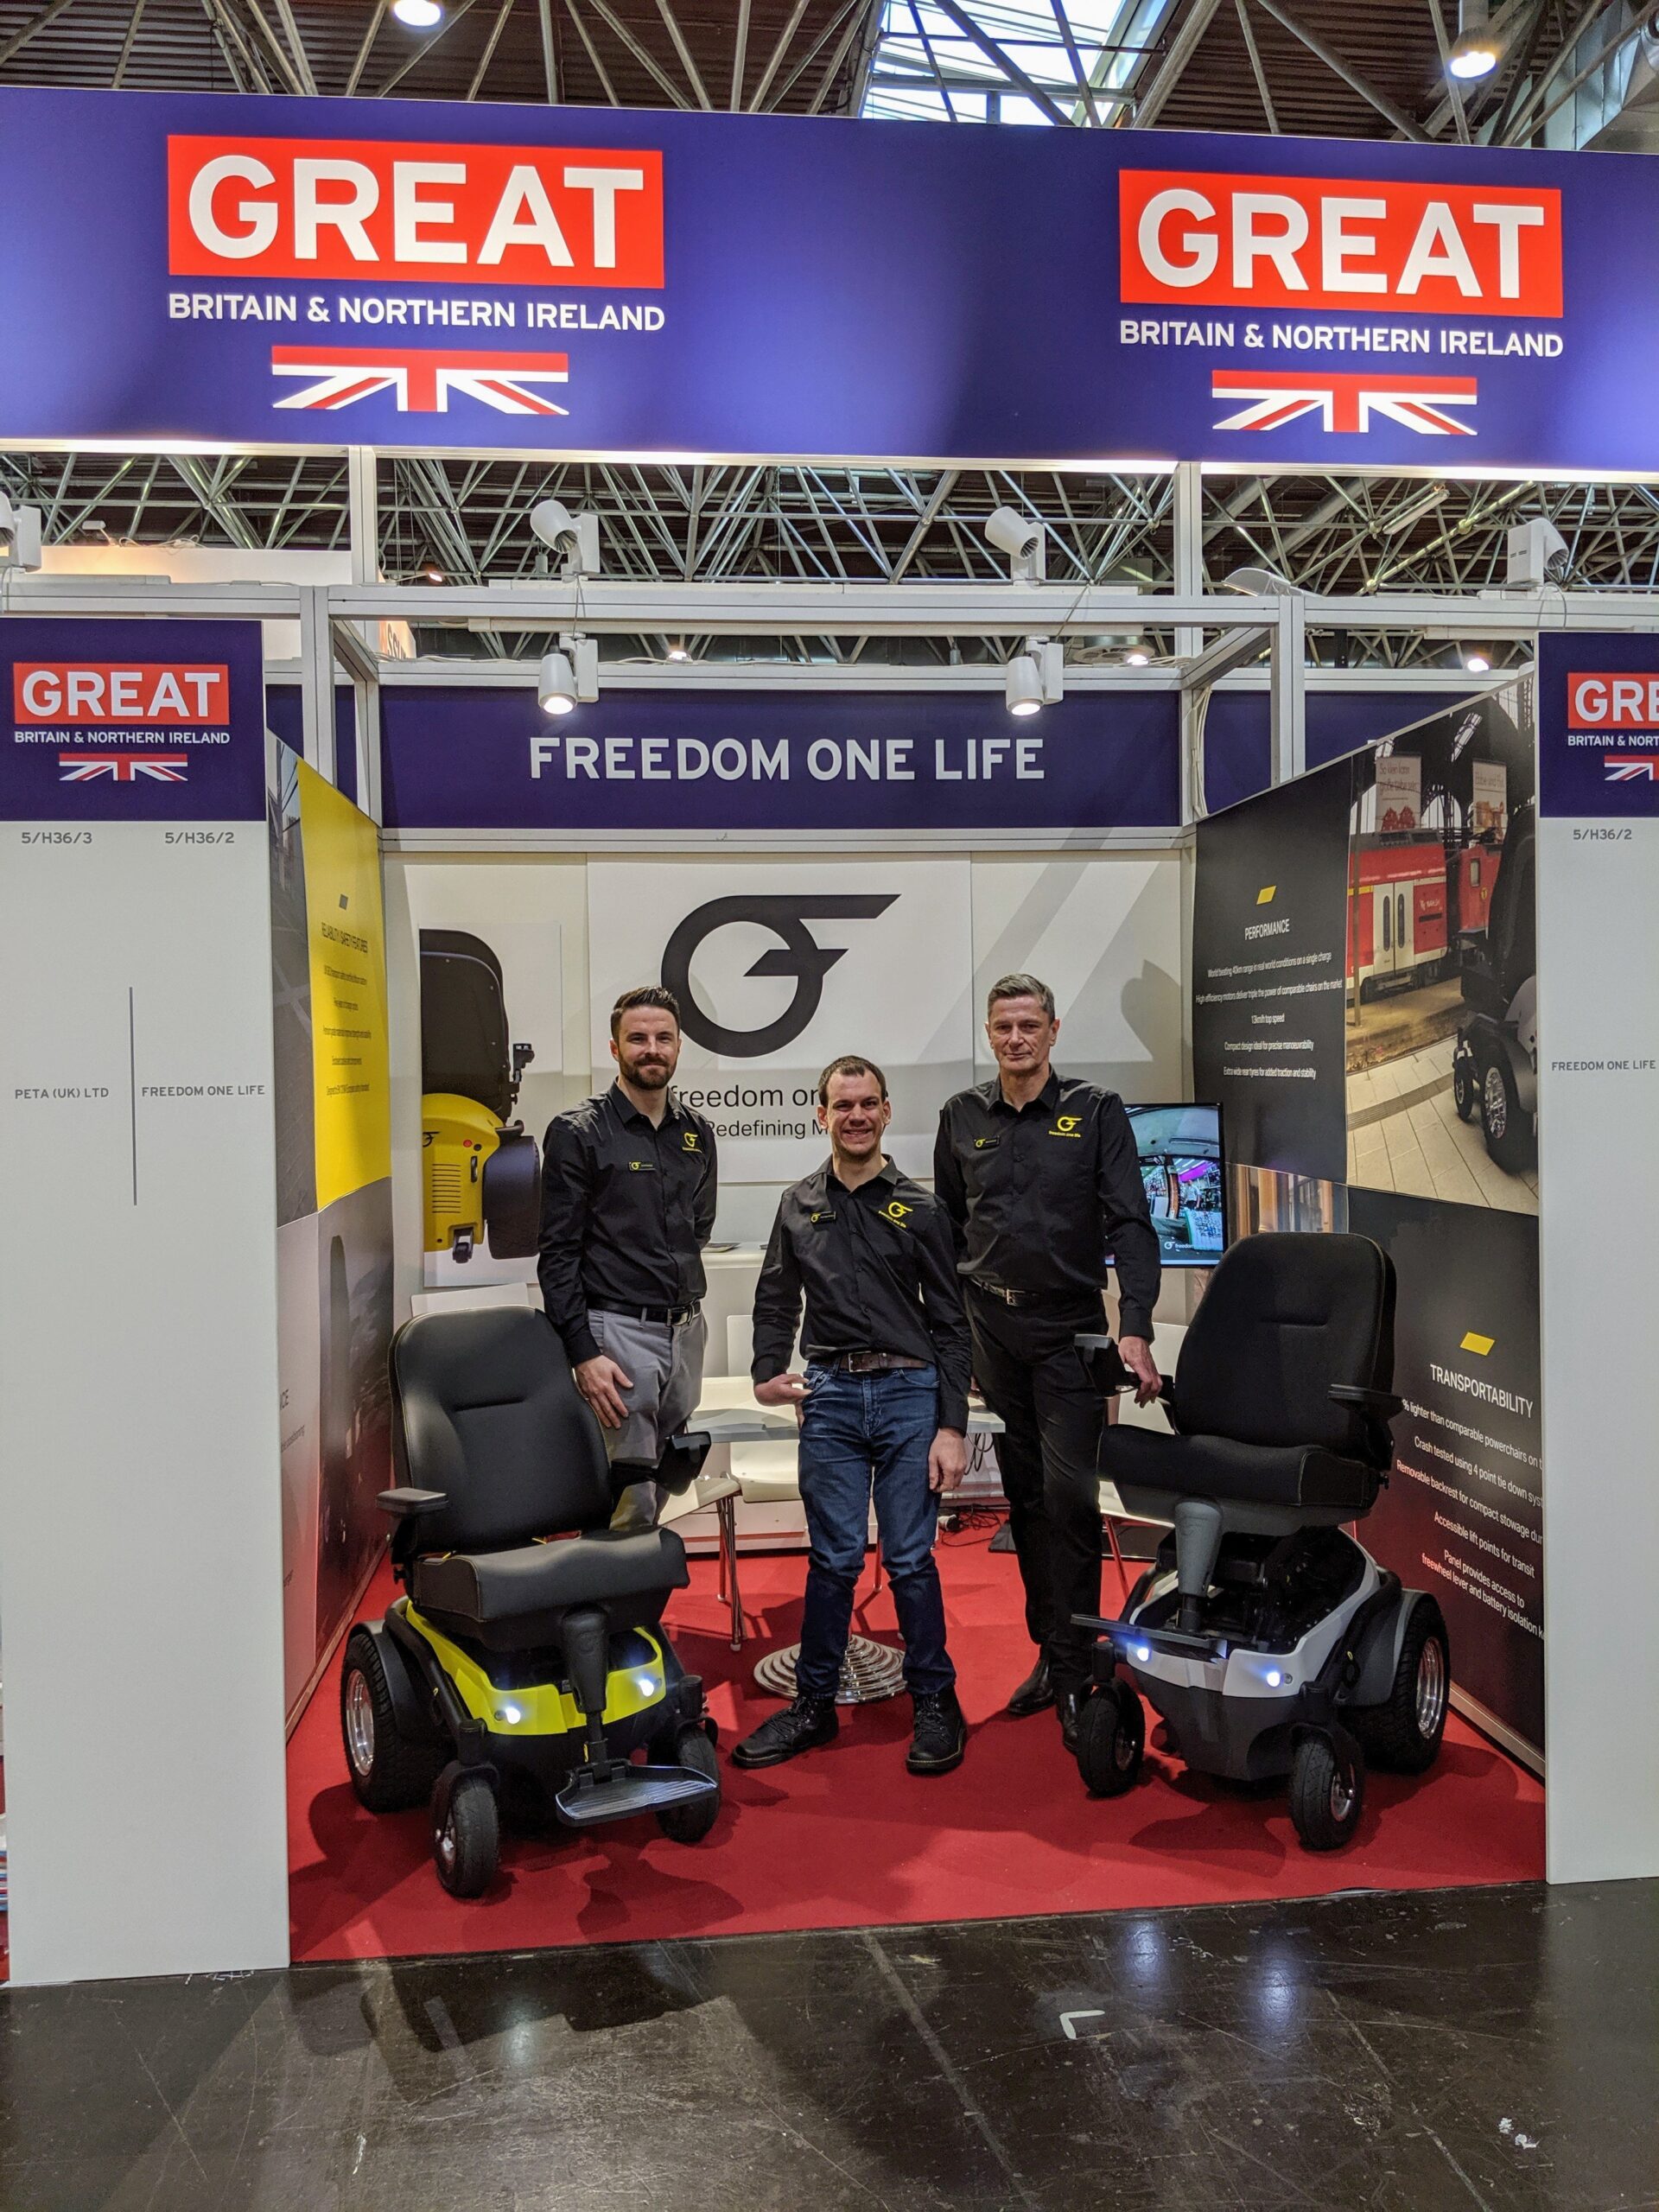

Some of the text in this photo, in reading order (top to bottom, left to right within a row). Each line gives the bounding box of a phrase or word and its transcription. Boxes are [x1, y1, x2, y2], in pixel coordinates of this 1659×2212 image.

[188, 154, 644, 269] GREAT
[1137, 188, 1545, 299] GREAT
[168, 292, 665, 332] BRITAIN & NORTHERN IRELAND
[1120, 320, 1564, 359] BRITAIN & NORTHERN IRELAND
[22, 670, 221, 717] GREAT
[14, 731, 231, 745] BRITAIN & NORTHERN IRELAND
[1567, 734, 1659, 747] BRITAIN & NORT
[529, 736, 1046, 781] FREEDOM ONE LIFE
[21, 831, 93, 845] 5/H36/3
[164, 831, 235, 845] 5/H36/2
[1572, 829, 1633, 841] 5/H36/2
[1244, 918, 1290, 941] PERFORMANCE
[1306, 952, 1318, 966] single
[1318, 950, 1332, 963] charge
[1281, 982, 1305, 995] comparable
[1305, 982, 1318, 993] chairs
[1272, 1013, 1285, 1025] speed
[1551, 1059, 1656, 1071] FREEDOM ONE LIFE
[14, 1087, 110, 1100] PETA (UK) LTD
[141, 1084, 266, 1097] FREEDOM ONE LIFE
[1430, 1363, 1534, 1419] TRANSPORTABILITY
[1409, 1401, 1429, 1420] lighter
[1429, 1409, 1445, 1426] than
[1445, 1418, 1484, 1444] comparable
[1484, 1434, 1527, 1463] powerchairs
[1528, 1454, 1538, 1468] on
[1414, 1434, 1433, 1454] Crash
[1433, 1444, 1453, 1464] tested
[1454, 1455, 1472, 1476] using
[1472, 1464, 1478, 1476] 4
[1478, 1468, 1497, 1484] point
[1497, 1475, 1507, 1490] tie
[1507, 1480, 1527, 1500] down
[1396, 1459, 1430, 1486] Removable
[1431, 1476, 1459, 1501] backrest
[1459, 1490, 1469, 1504] for
[1469, 1497, 1499, 1522] compact
[1499, 1511, 1529, 1539] stowage
[1433, 1510, 1535, 1579] Accessible lift points for transit
[1421, 1552, 1452, 1580] freewheel
[1452, 1571, 1469, 1591] lever
[1469, 1584, 1482, 1599] and
[1482, 1590, 1506, 1618] battery
[1507, 1605, 1537, 1636] isolation
[1444, 1549, 1525, 1608] Panel provides access to
